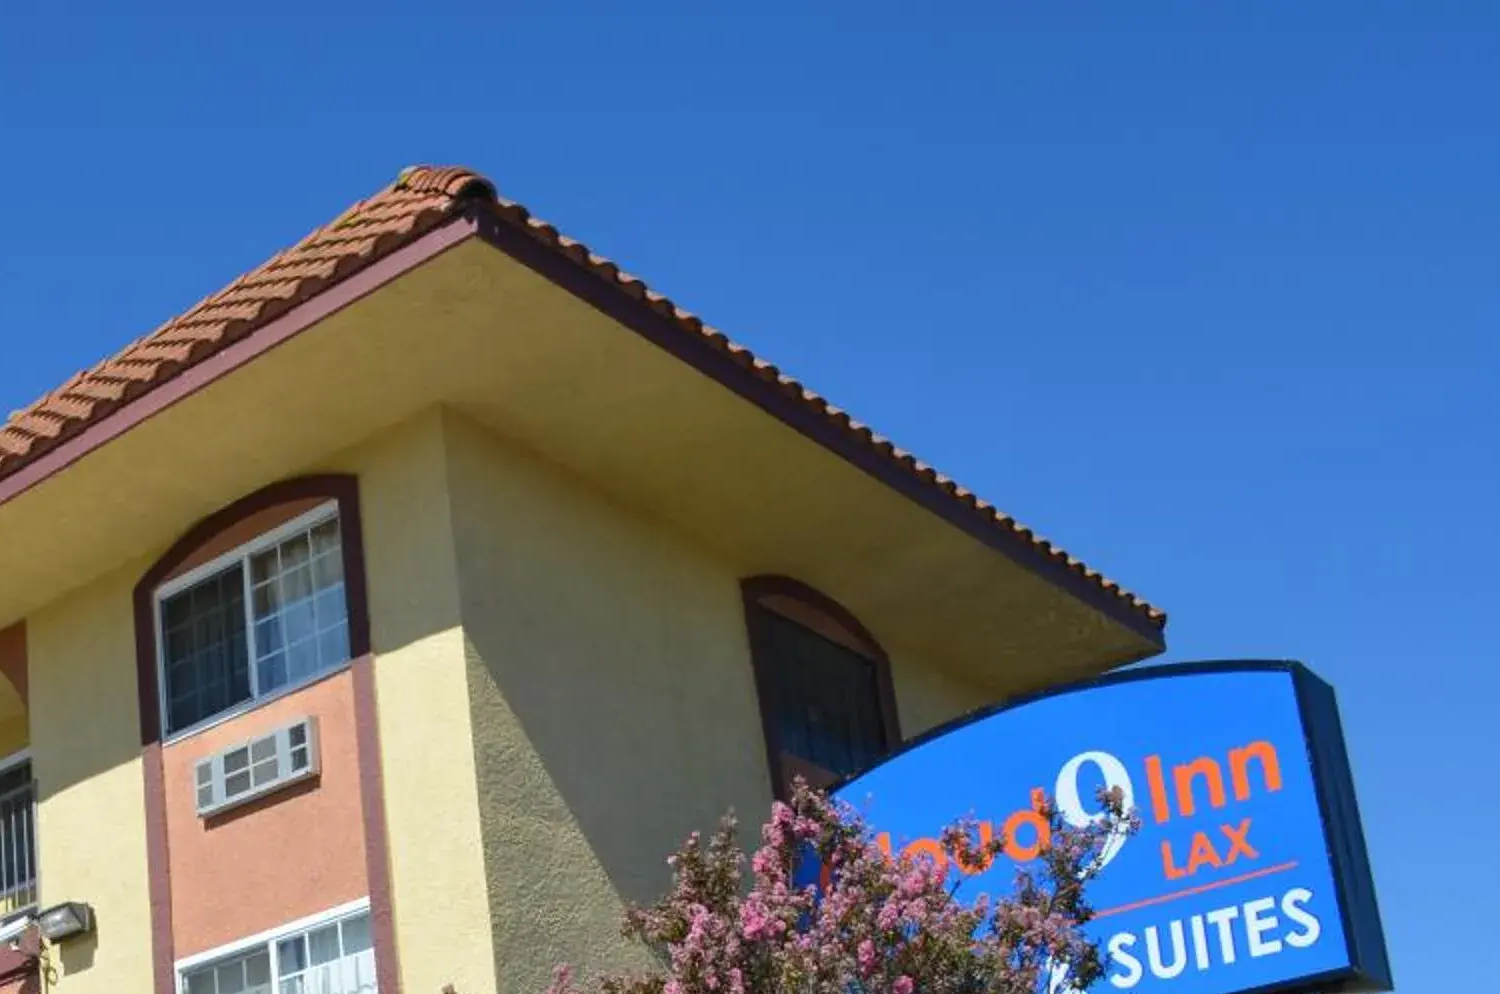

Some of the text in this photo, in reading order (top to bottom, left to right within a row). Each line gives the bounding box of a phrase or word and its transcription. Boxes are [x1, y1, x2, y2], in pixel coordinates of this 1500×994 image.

[1144, 740, 1282, 823] Inn
[1160, 818, 1259, 881] LAX
[1106, 887, 1321, 989] SUITES
